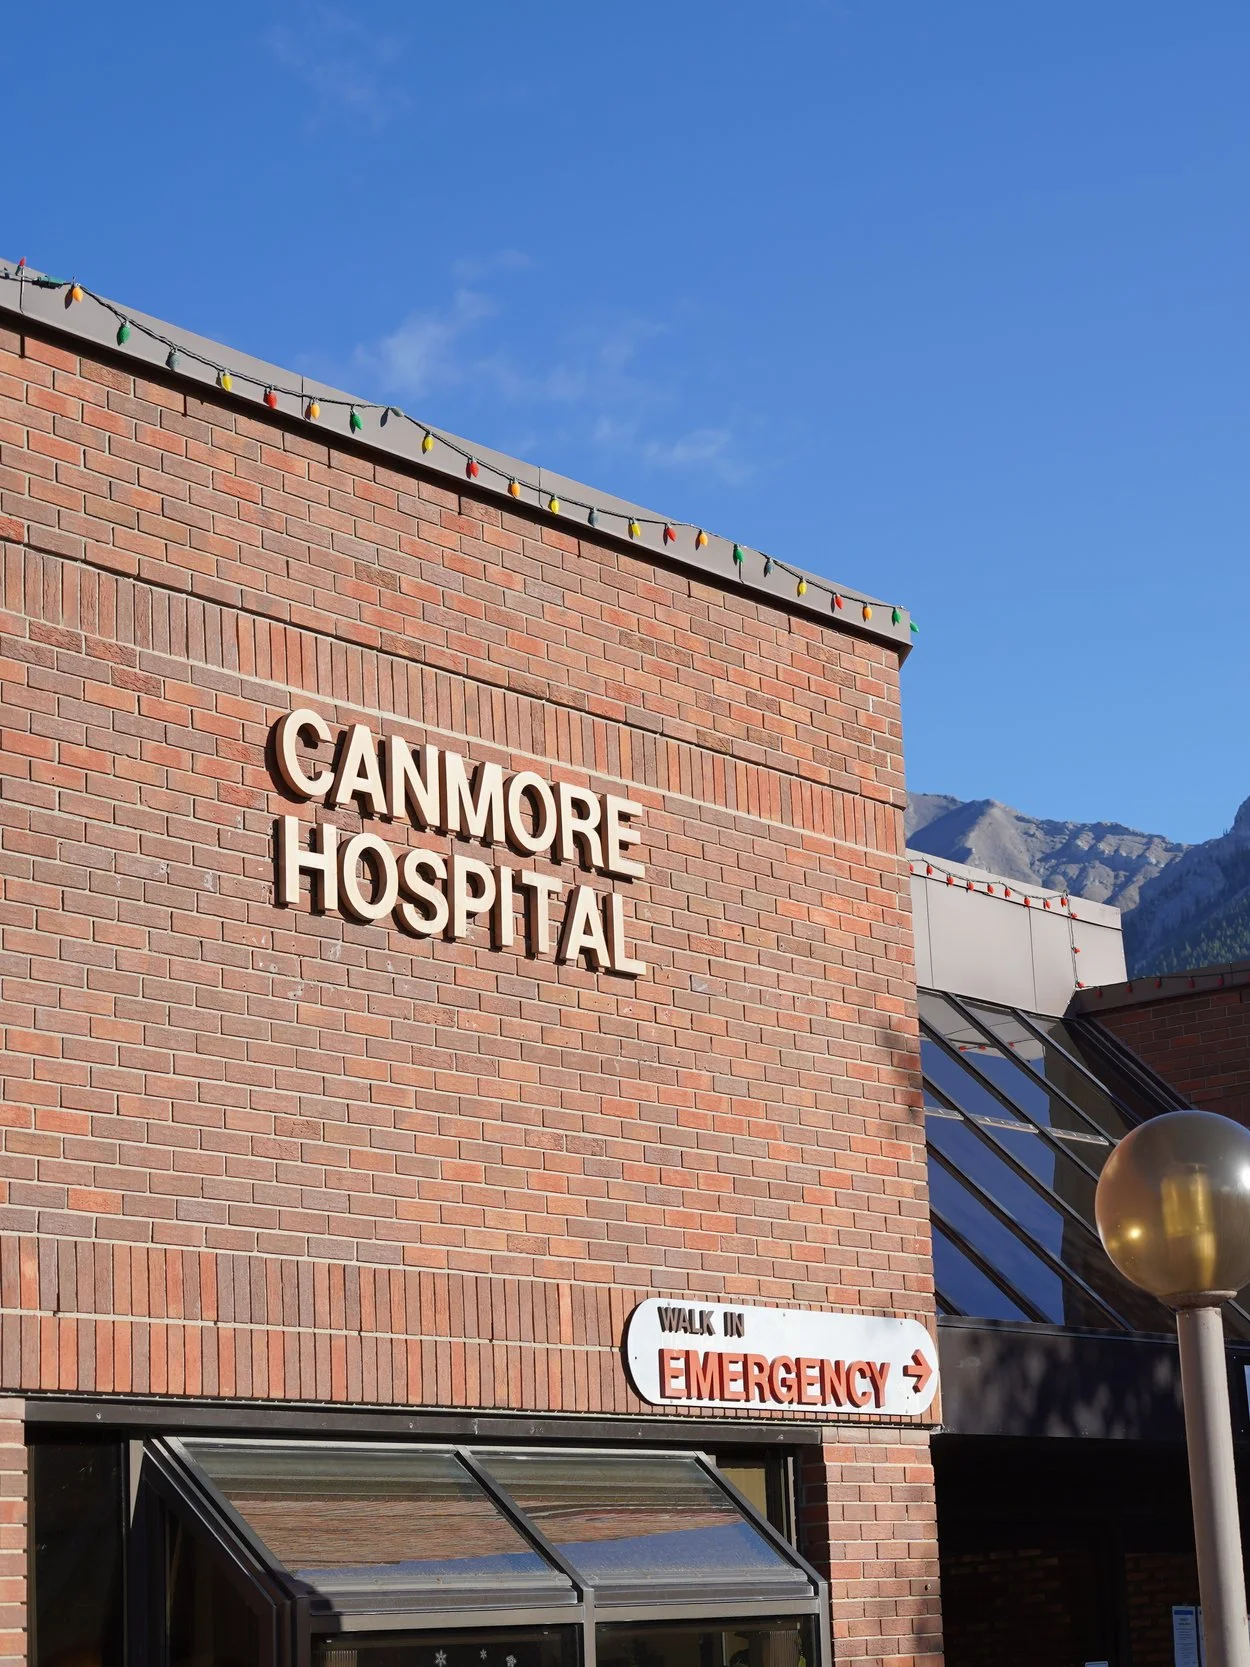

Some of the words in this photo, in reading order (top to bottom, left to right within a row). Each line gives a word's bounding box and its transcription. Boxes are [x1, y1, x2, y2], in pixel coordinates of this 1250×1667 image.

[276, 709, 645, 879] CANMORE
[278, 815, 647, 976] HOSPITAL
[657, 1306, 716, 1337] WALK
[723, 1311, 745, 1338] IN
[658, 1348, 891, 1409] EMERGENCY
